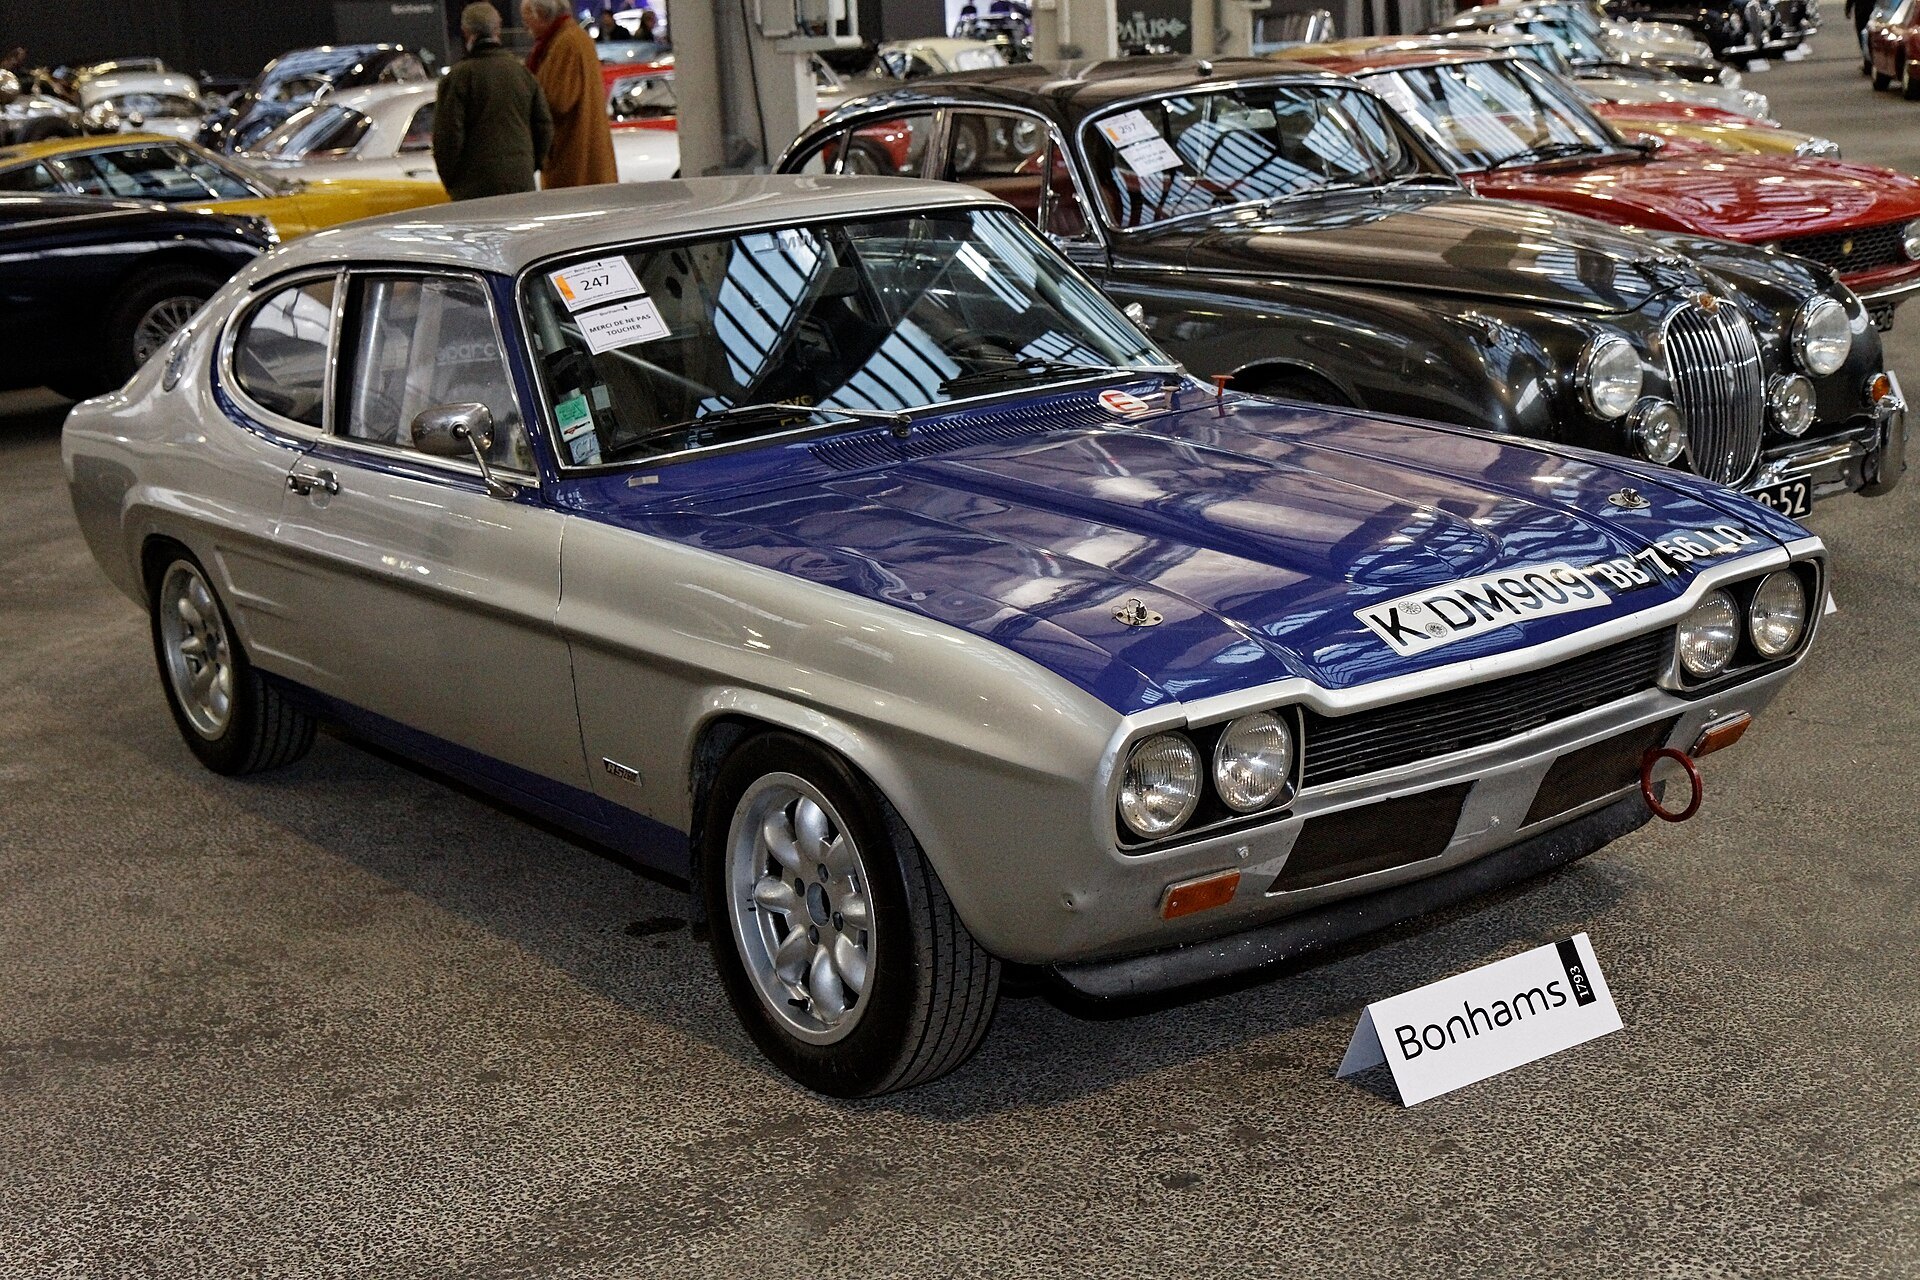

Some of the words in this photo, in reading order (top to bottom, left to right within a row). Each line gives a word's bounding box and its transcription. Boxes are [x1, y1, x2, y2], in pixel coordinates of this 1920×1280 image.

[580, 274, 609, 291] 247
[589, 323, 613, 334] MERCI
[613, 319, 624, 327] DE
[625, 316, 636, 324] NE
[636, 313, 651, 322] PAS
[606, 323, 642, 337] TOUCHER
[1369, 607, 1432, 647] K
[1422, 568, 1597, 632] DM909
[1395, 980, 1567, 1061] Bonhams
[1569, 965, 1590, 998] 1793
